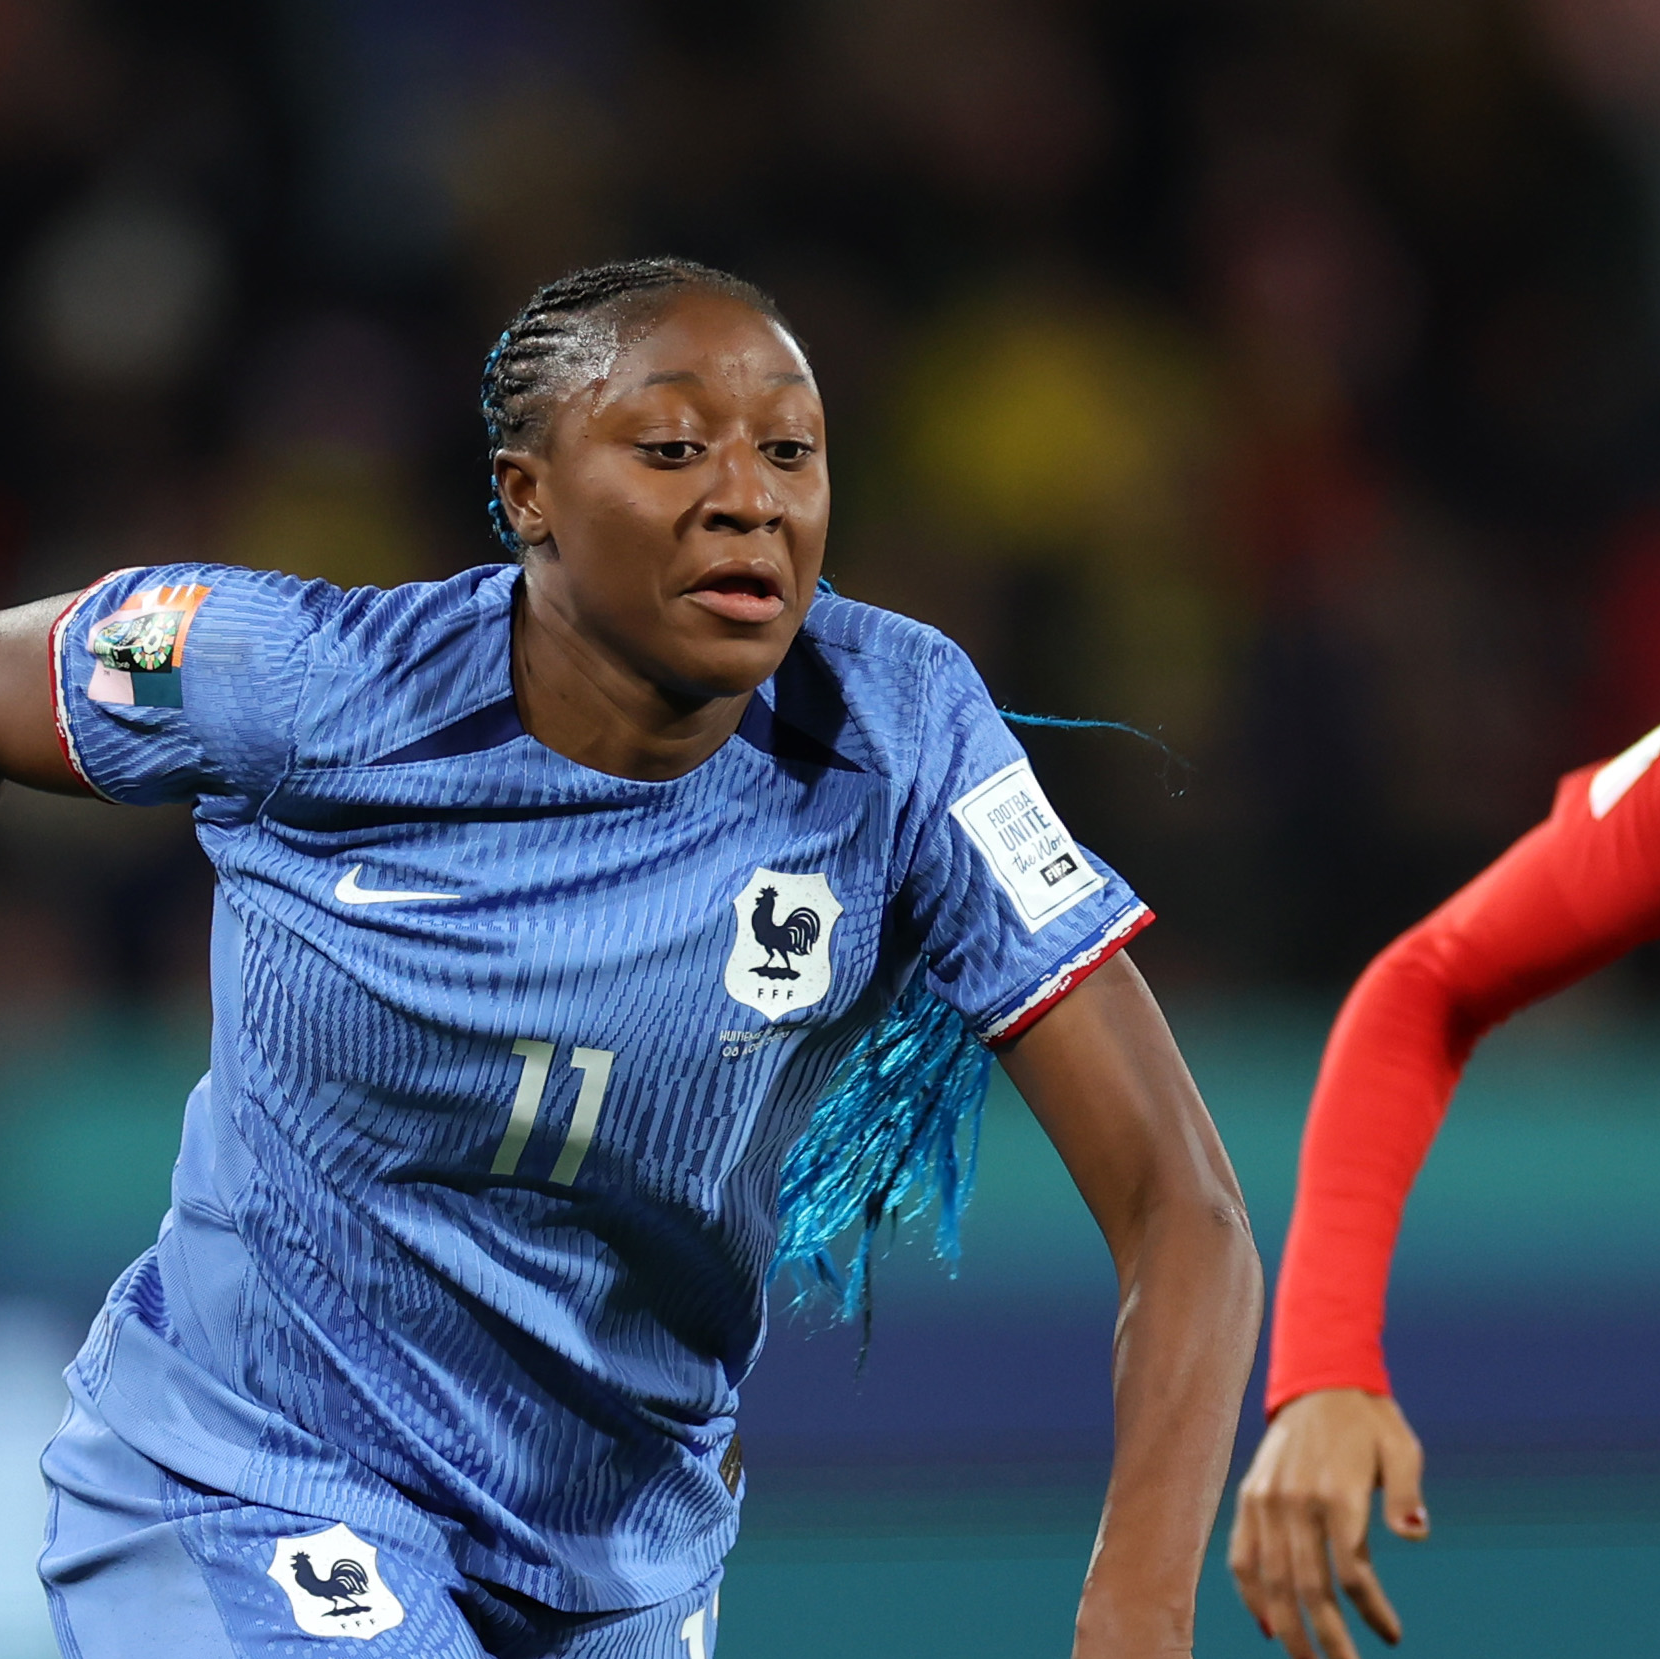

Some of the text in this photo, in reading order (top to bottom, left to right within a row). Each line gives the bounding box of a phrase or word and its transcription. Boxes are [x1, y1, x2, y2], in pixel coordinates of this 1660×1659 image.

[987, 790, 1035, 829] FOOTBA
[1044, 859, 1073, 882] FIFA
[490, 1037, 616, 1188] 11
